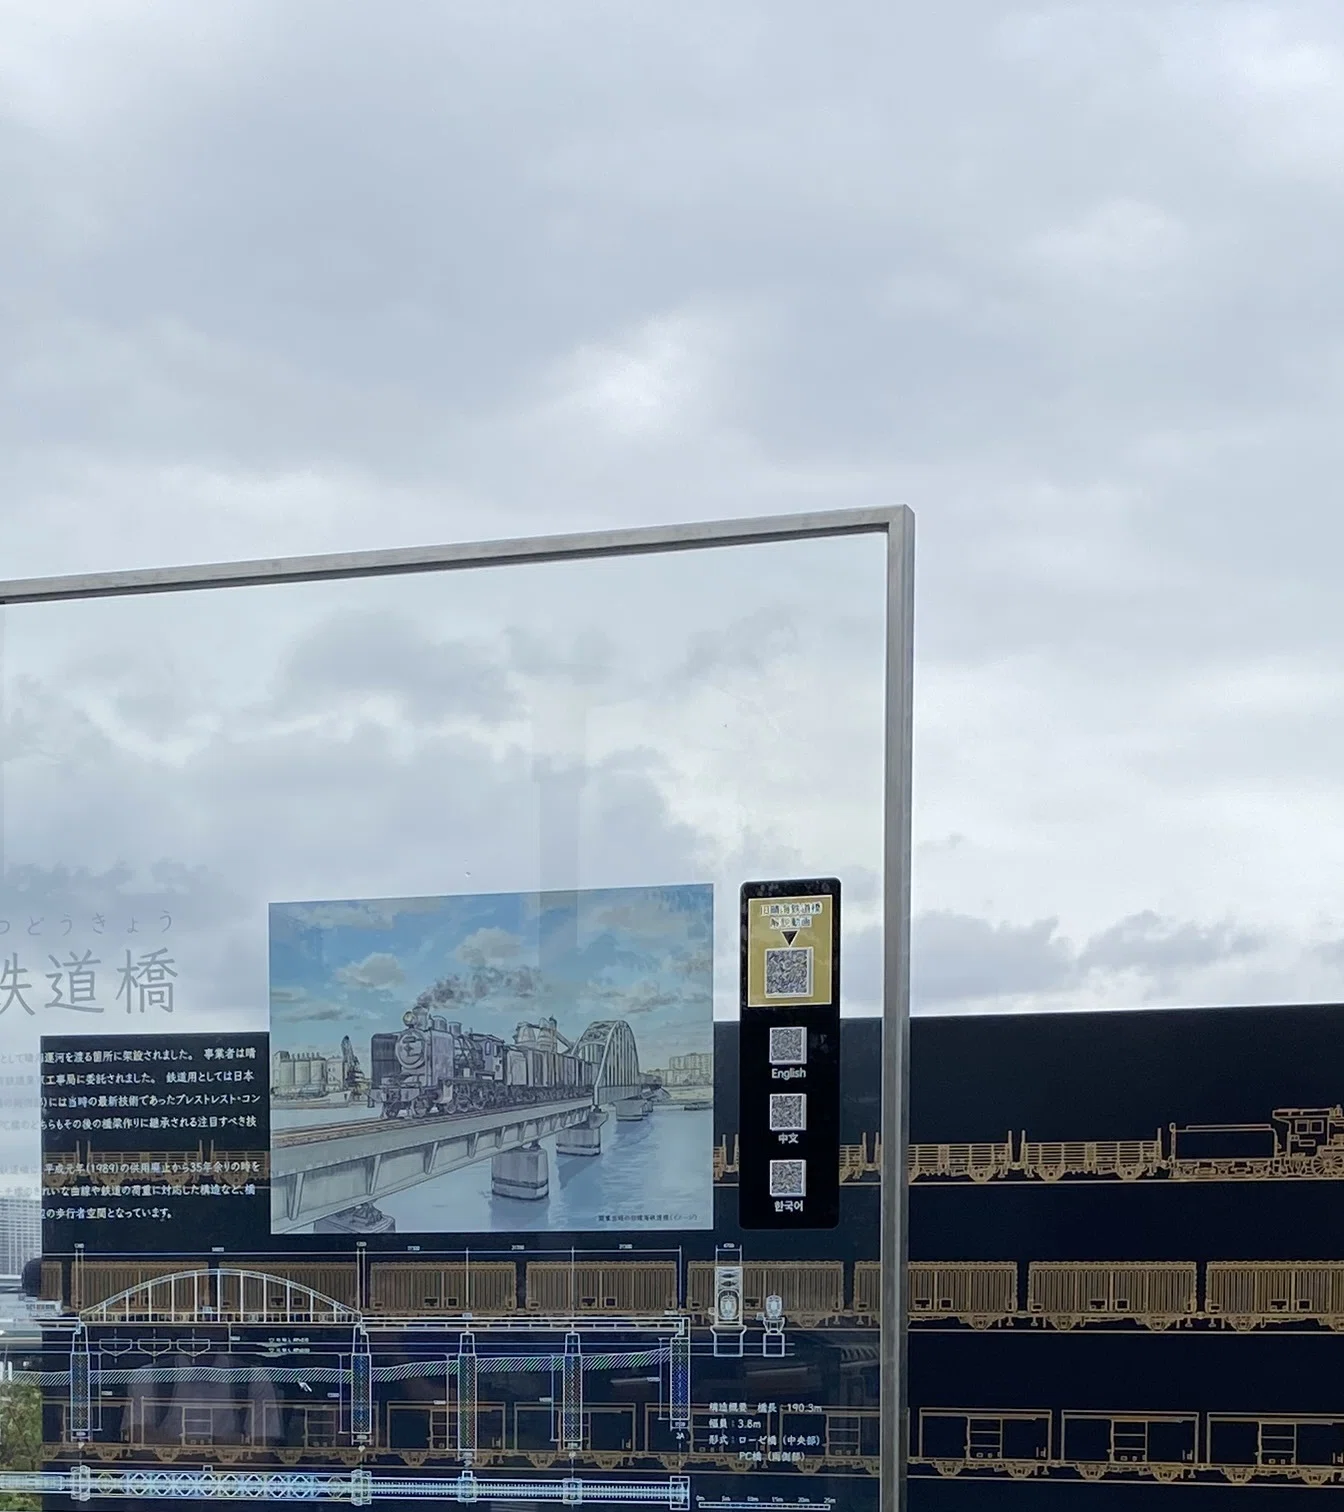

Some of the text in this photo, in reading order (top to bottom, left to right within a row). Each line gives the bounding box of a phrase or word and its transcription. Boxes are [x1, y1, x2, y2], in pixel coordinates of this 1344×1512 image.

[771, 1068, 806, 1080] English
[778, 1132, 799, 1144] 中文
[774, 1200, 804, 1212] 한국어
